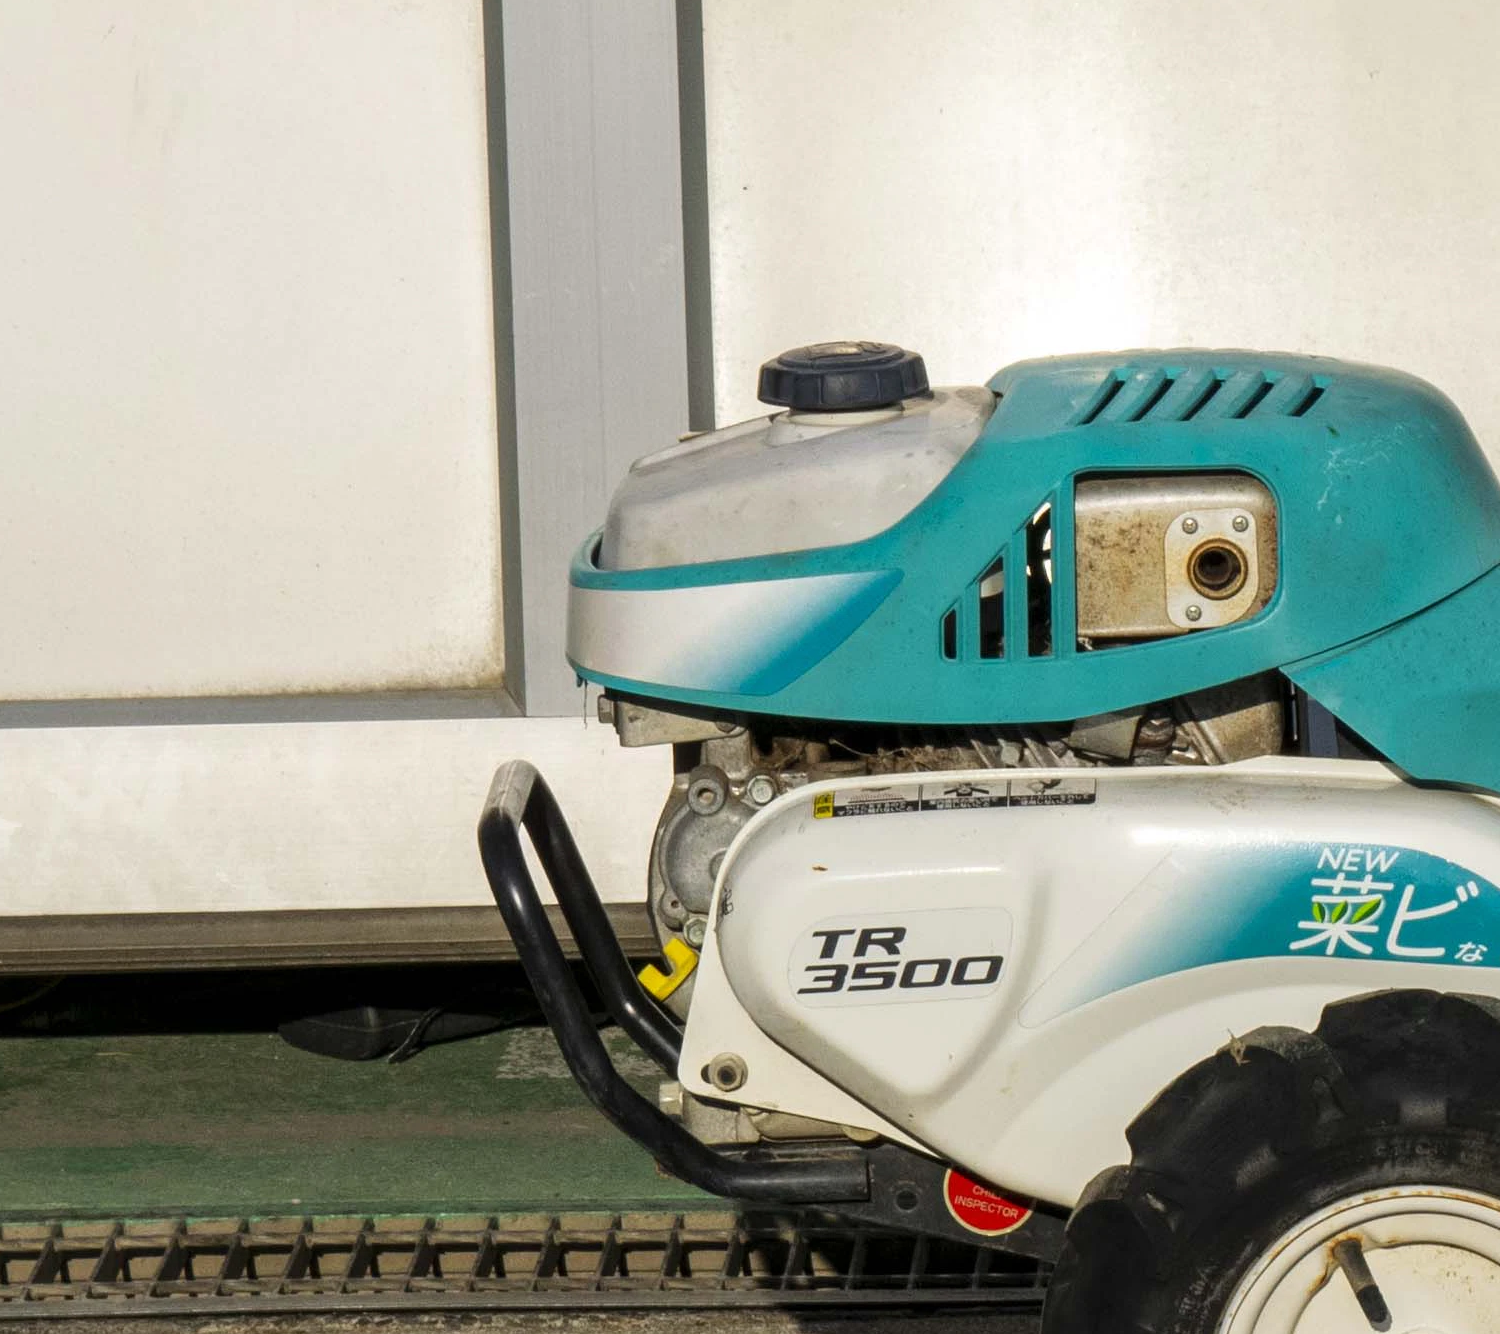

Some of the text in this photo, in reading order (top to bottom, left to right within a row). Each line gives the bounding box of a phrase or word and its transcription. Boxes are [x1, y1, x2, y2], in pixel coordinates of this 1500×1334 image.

[1317, 847, 1400, 873] NEW
[812, 927, 907, 960] TR
[797, 955, 1004, 995] 3500
[954, 1195, 1019, 1220] INSPECTOR
